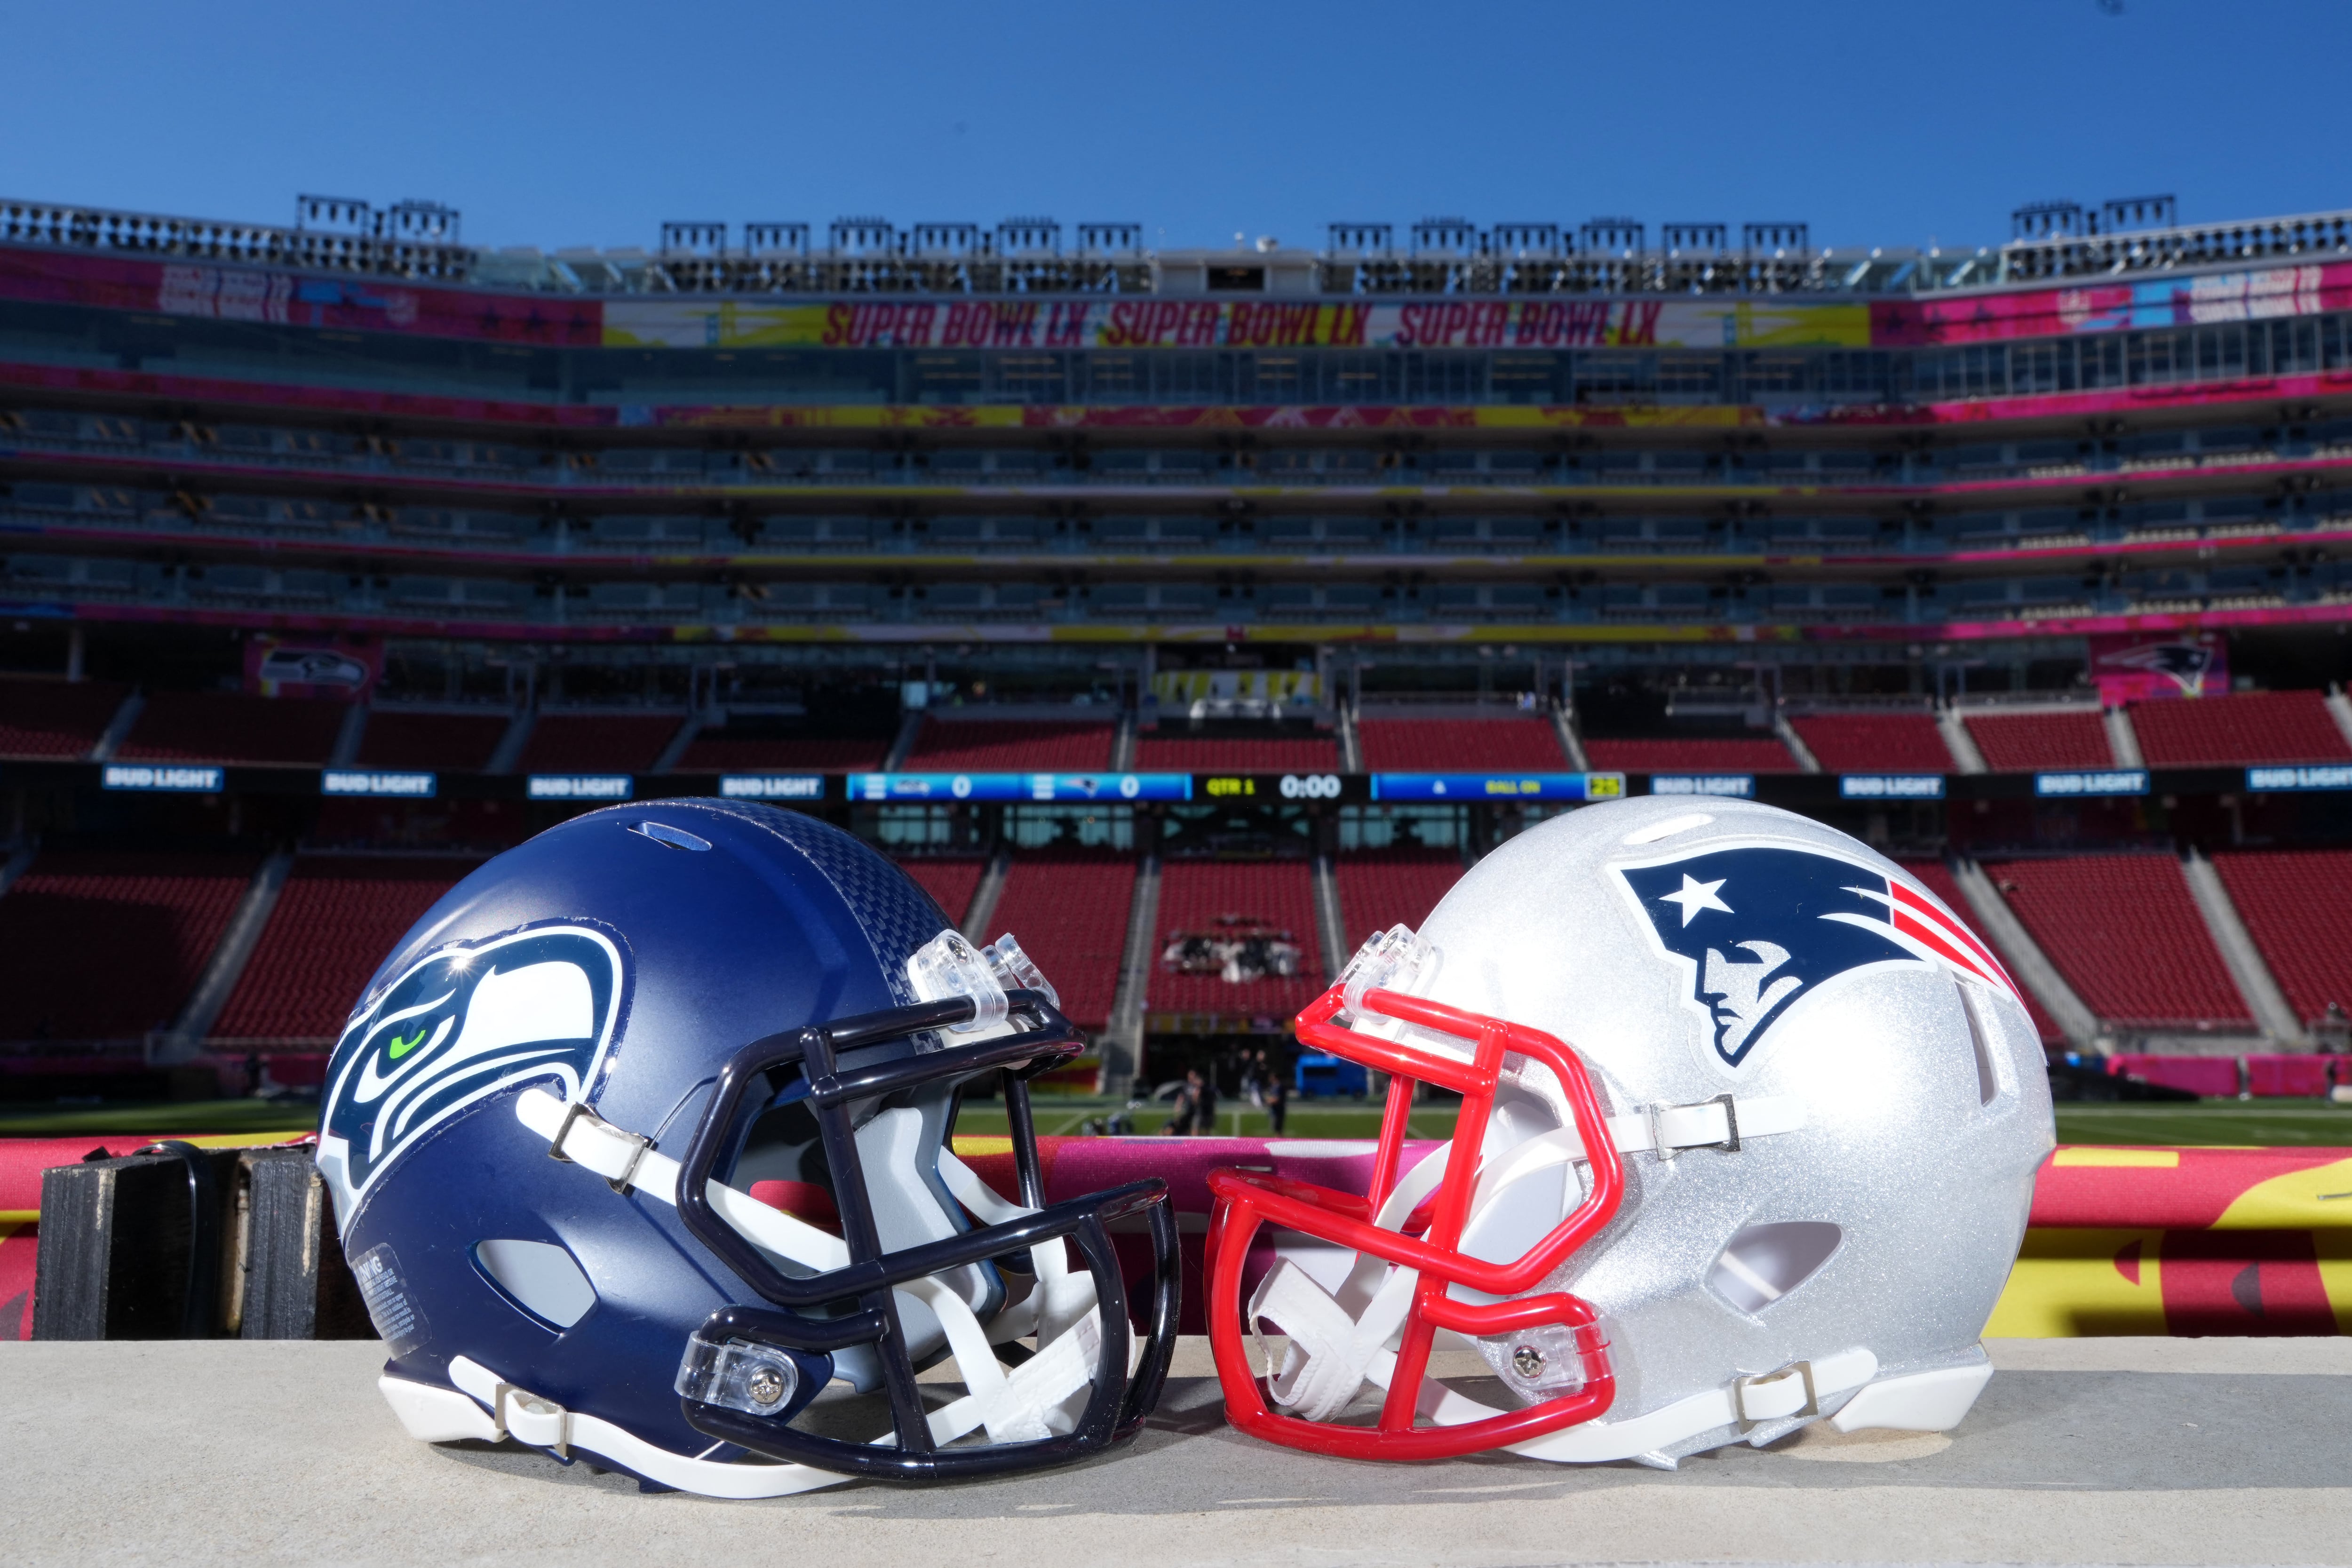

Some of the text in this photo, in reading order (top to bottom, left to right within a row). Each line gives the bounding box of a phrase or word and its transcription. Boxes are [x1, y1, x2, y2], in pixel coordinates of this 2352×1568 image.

[823, 302, 1090, 347] SUPER BOWL LX
[1107, 301, 1374, 346] SUPER BOWL LX
[1396, 301, 1662, 346] SUPER BOWL LX
[106, 768, 215, 787] BUD LIGHT
[325, 775, 429, 792] BUD LIGHT
[952, 775, 972, 798] 0
[1120, 775, 1140, 798] 0
[1279, 774, 1341, 798] 0:00
[1844, 779, 1941, 794] BUD LIGHT
[2039, 774, 2144, 791] BUD LIGHT
[2251, 770, 2296, 786] BUD
[531, 780, 627, 795] BUD LIGHT
[723, 779, 818, 795] BUD LIGHT
[1206, 778, 1255, 796] QTR 1
[1653, 779, 1751, 795] BUD LIGHT
